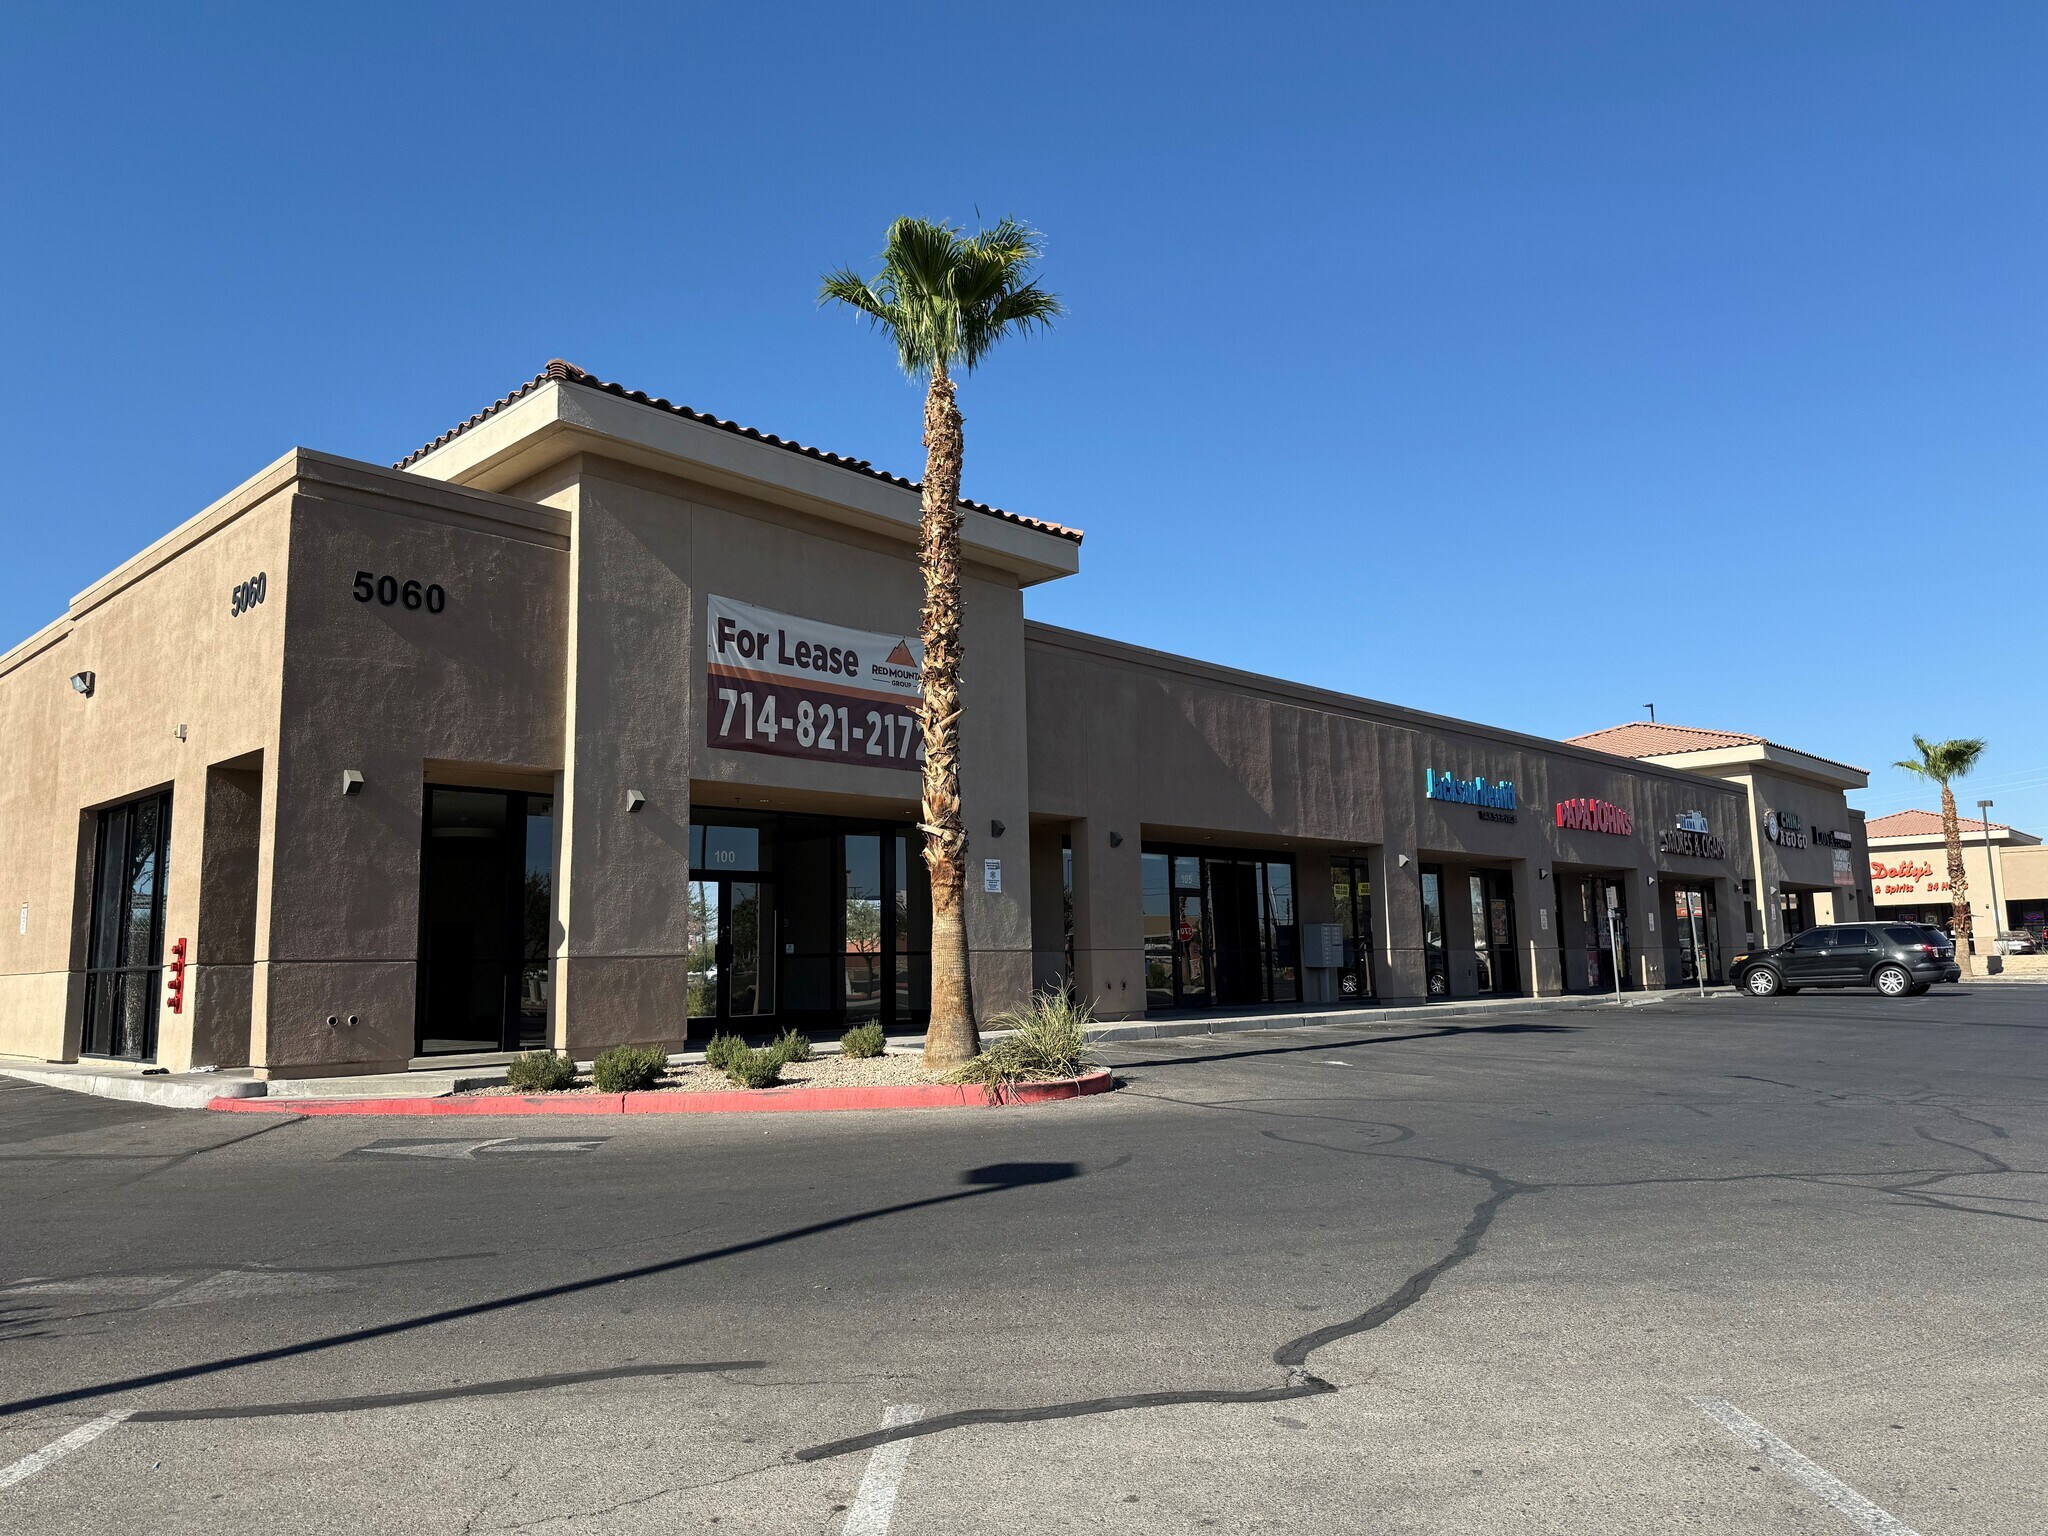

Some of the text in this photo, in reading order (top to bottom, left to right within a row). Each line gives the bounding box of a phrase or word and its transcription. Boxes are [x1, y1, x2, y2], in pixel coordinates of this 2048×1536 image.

[231, 571, 267, 618] 5060
[352, 570, 446, 614] 5060
[717, 616, 860, 678] For Lease
[872, 664, 922, 681] RED MOUNTA
[891, 680, 912, 689] GROUP
[1426, 768, 1518, 811] Jackson Hewitt
[1778, 812, 1802, 831] CHINA
[1660, 829, 1726, 860] SMOKES & CIGARS
[714, 850, 736, 864] 100
[1833, 861, 1851, 872] HIRING
[1871, 860, 1934, 884] Dotty's
[1181, 874, 1193, 884] 105
[1927, 882, 1939, 892] 24
[1874, 883, 1914, 896] & Spirits
